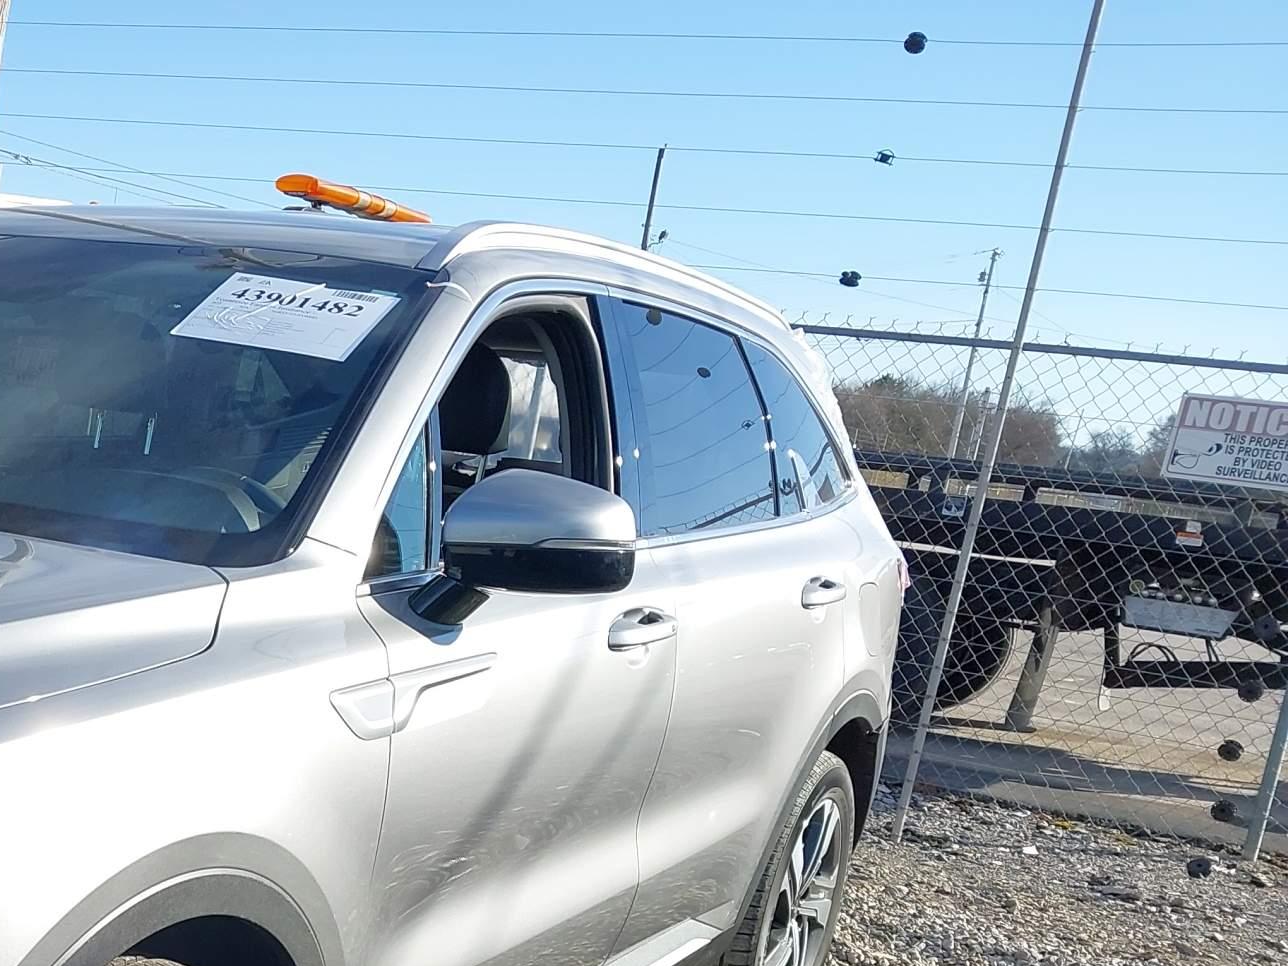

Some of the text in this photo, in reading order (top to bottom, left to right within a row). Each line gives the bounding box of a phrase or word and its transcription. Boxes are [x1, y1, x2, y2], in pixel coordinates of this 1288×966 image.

[231, 287, 366, 317] 43901482
[1224, 433, 1247, 445] THIS
[1224, 445, 1235, 455] IS
[1233, 457, 1282, 471] BY VIDEO
[1215, 467, 1288, 483] SURVEILLANC
